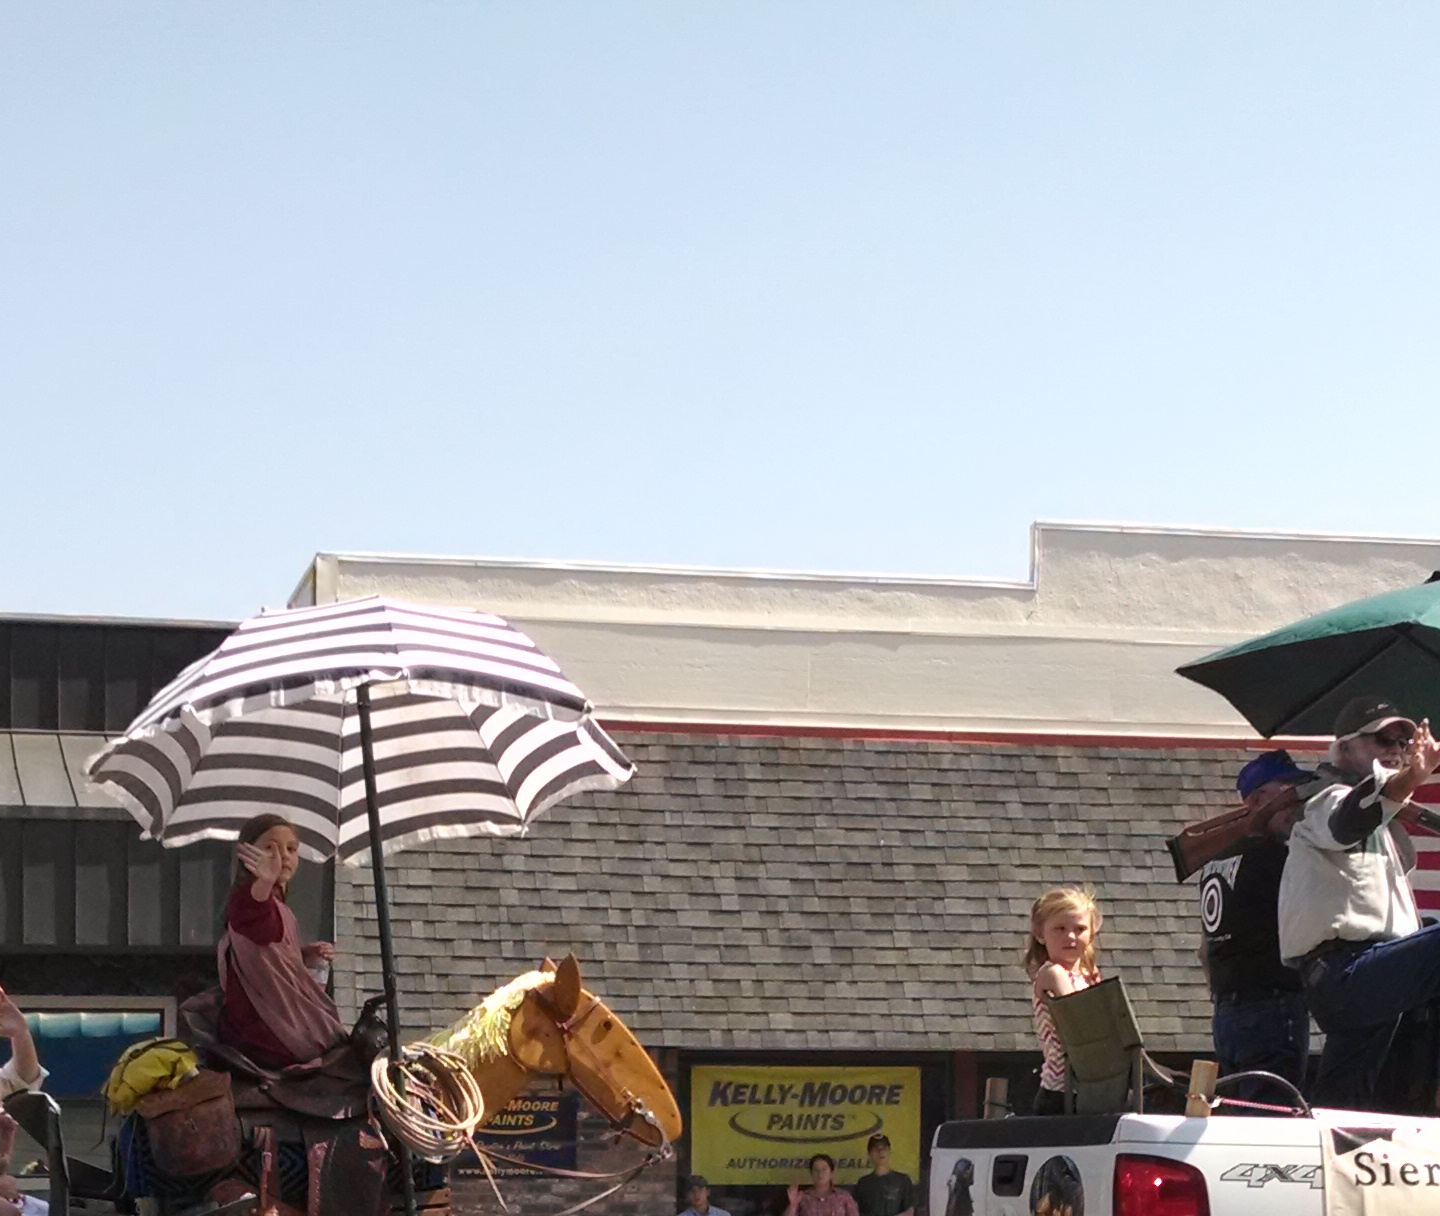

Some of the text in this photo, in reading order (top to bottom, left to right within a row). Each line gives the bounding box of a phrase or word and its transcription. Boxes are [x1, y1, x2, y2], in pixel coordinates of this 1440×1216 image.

[708, 1081, 904, 1107] KELLY-MOORE
[766, 1113, 845, 1131] PAINTS
[726, 1158, 811, 1169] AUTHORIZE
